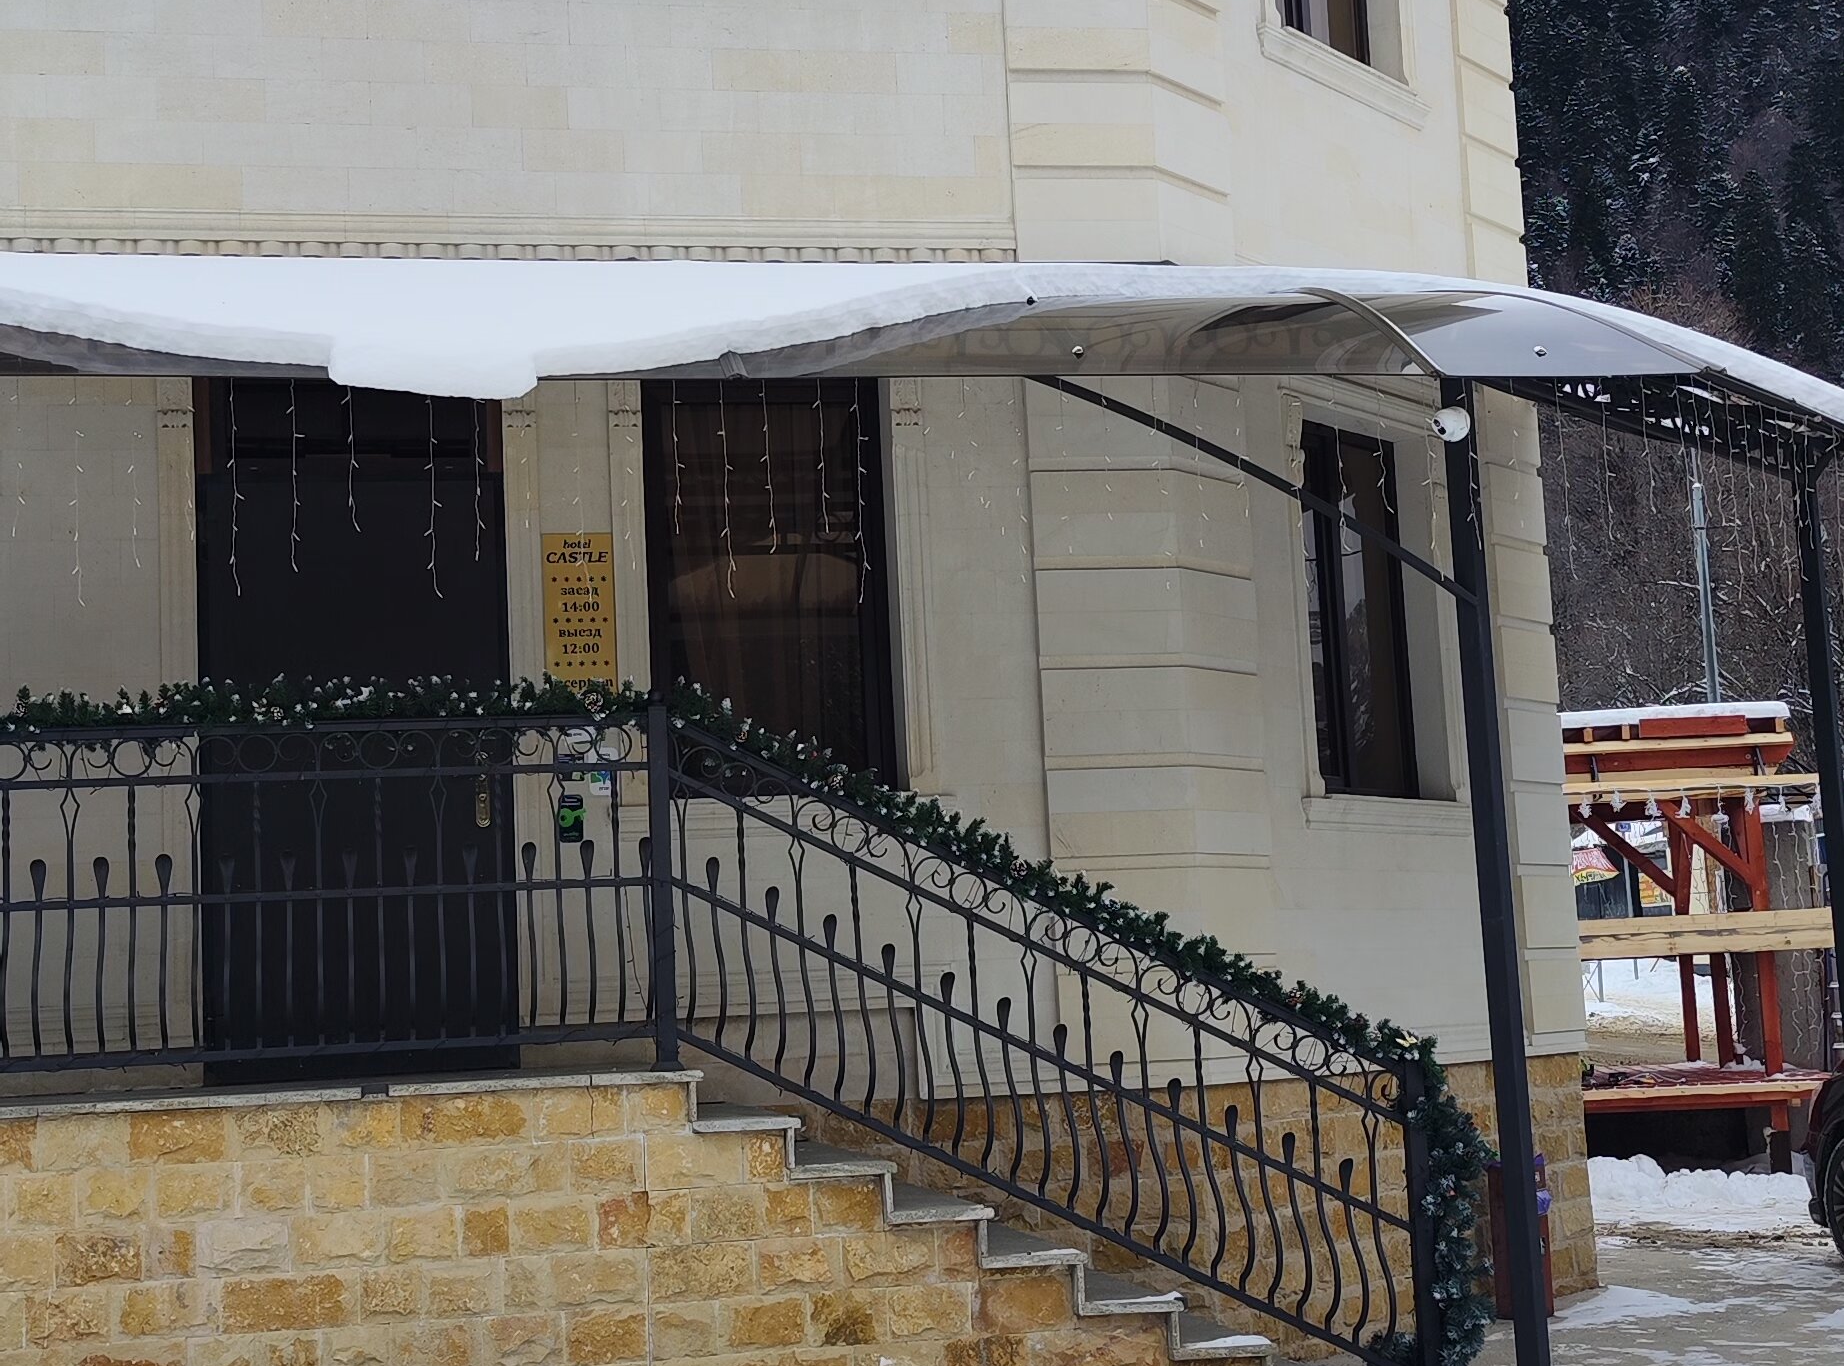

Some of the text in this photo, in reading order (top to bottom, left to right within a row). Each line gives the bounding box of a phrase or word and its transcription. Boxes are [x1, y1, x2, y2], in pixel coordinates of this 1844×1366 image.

[563, 539, 591, 549] hotel
[546, 552, 608, 563] CASTLE
[562, 602, 600, 612] 14:00
[558, 629, 602, 638] выезд
[562, 643, 600, 654] 12:00
